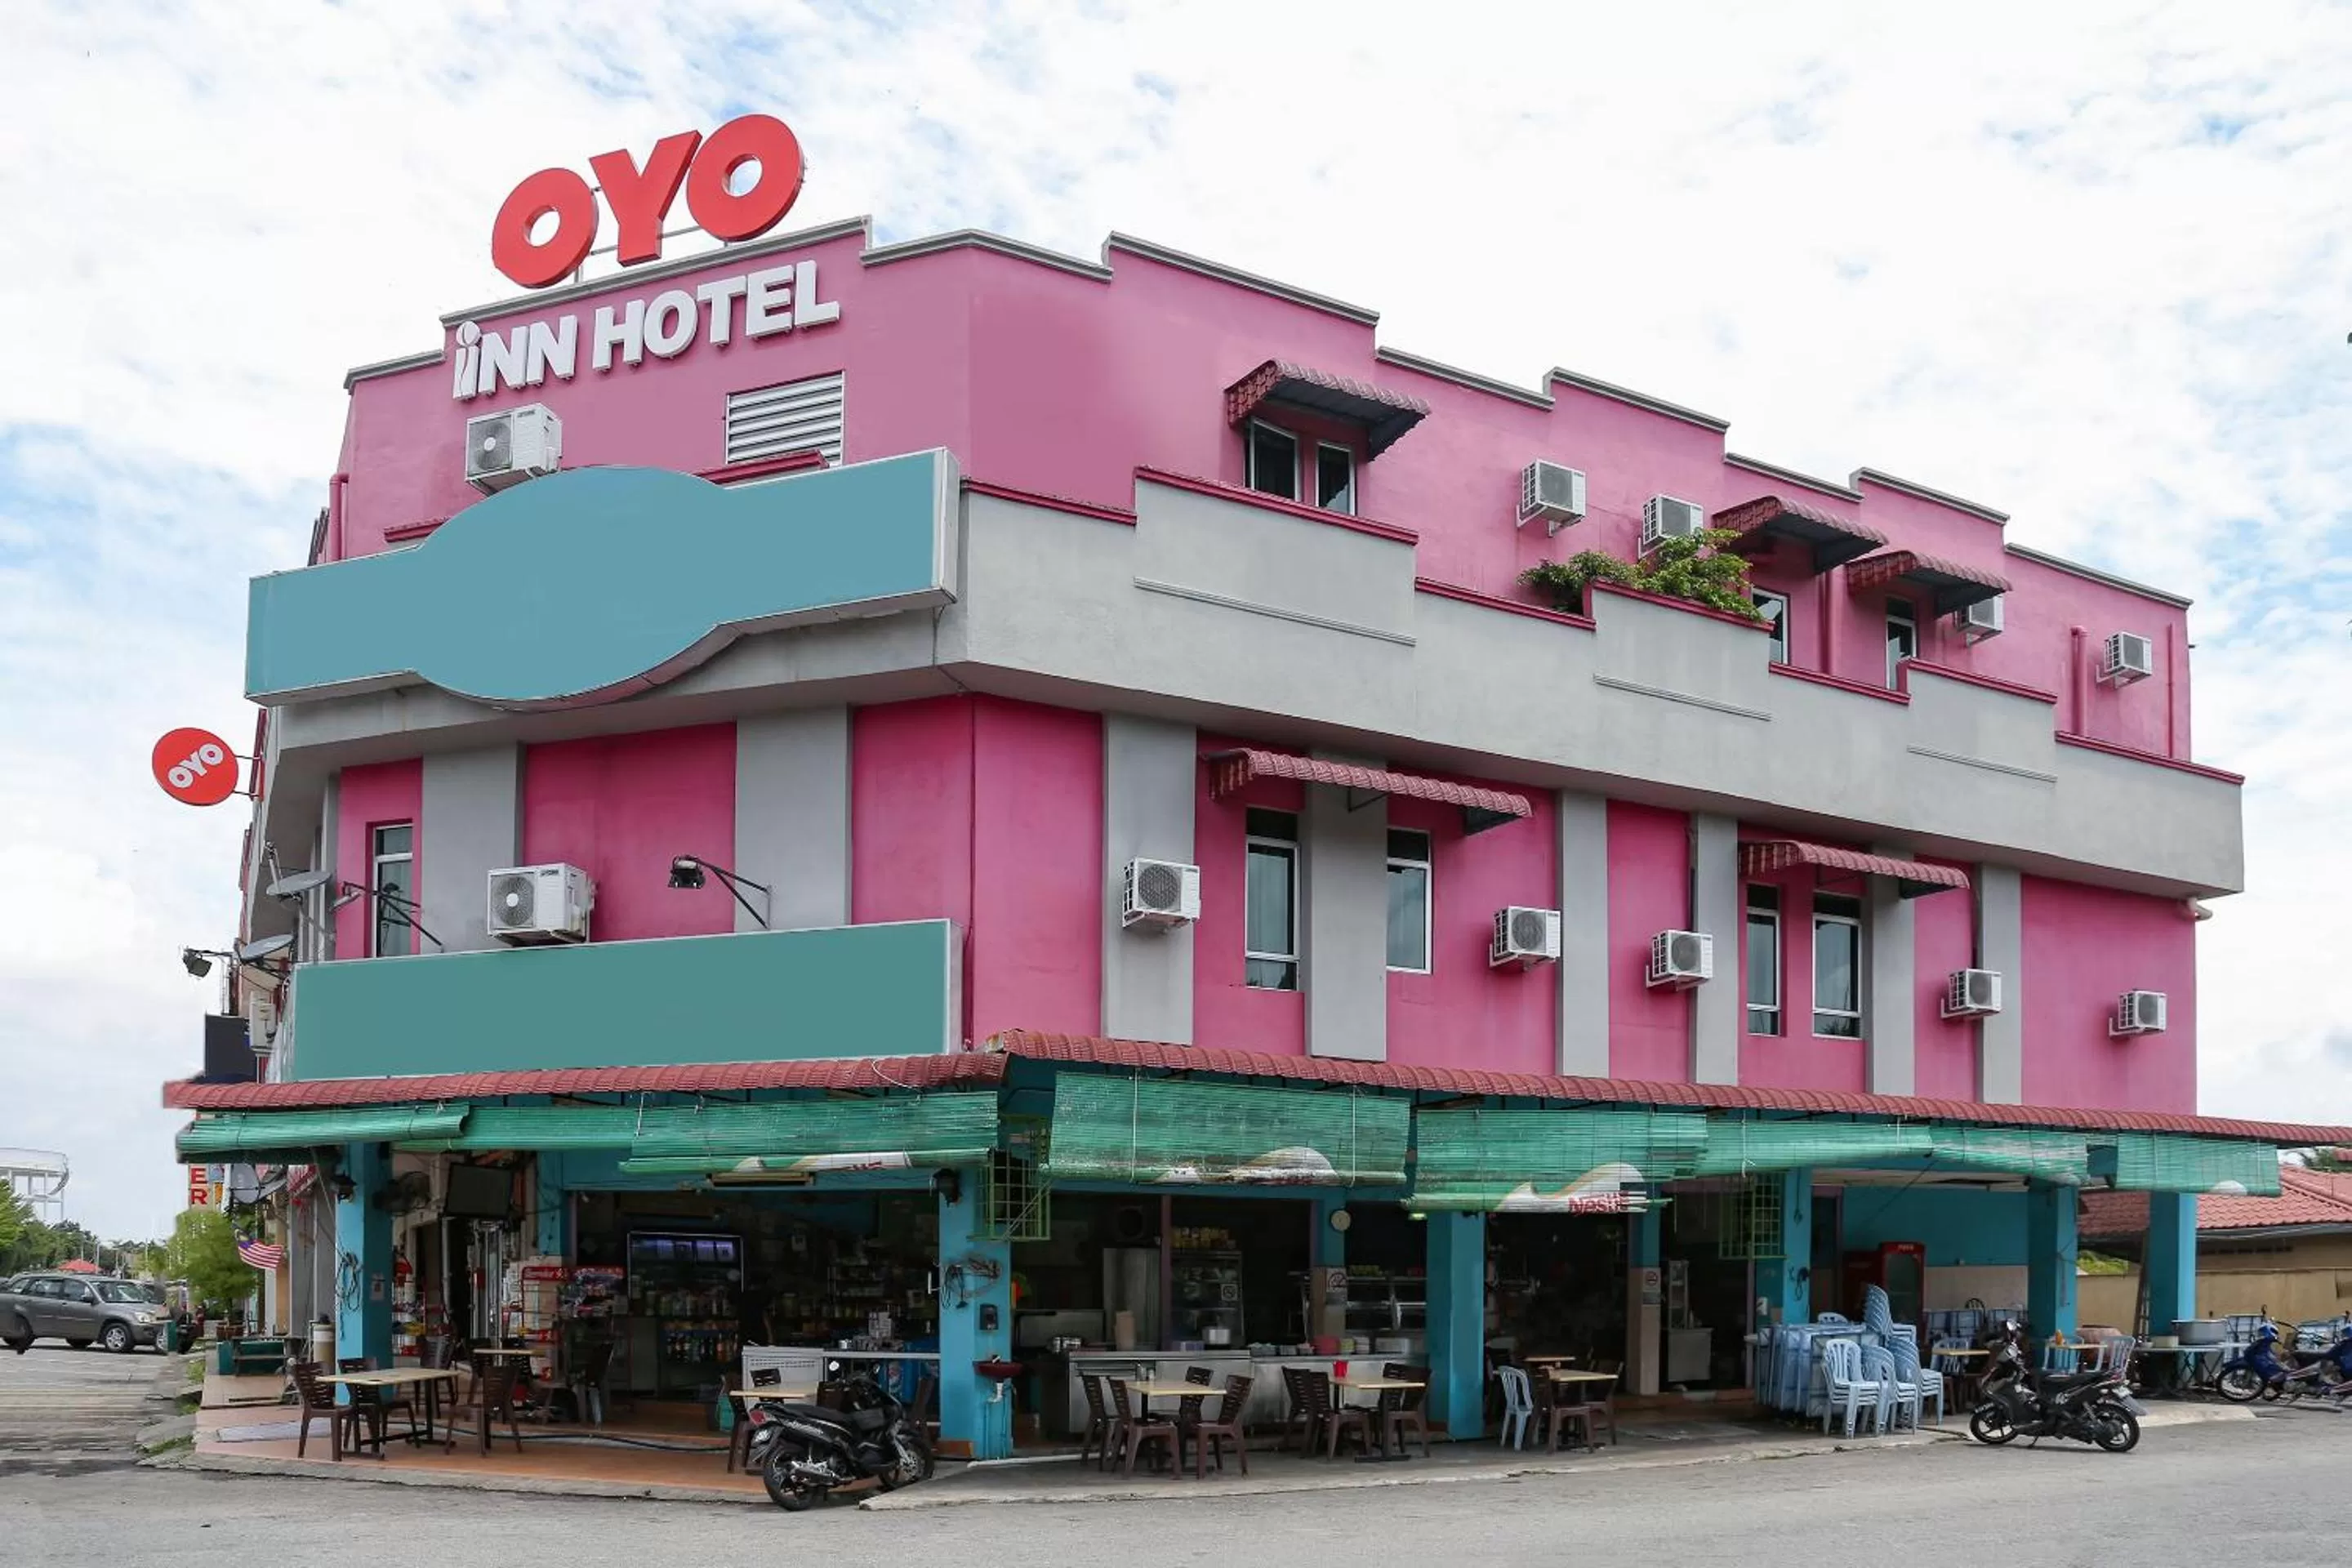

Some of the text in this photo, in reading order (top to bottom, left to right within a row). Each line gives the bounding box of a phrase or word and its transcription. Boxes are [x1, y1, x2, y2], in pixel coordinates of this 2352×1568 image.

[492, 114, 804, 289] OYO
[592, 260, 840, 372] HOTEL
[167, 742, 224, 788] OYO
